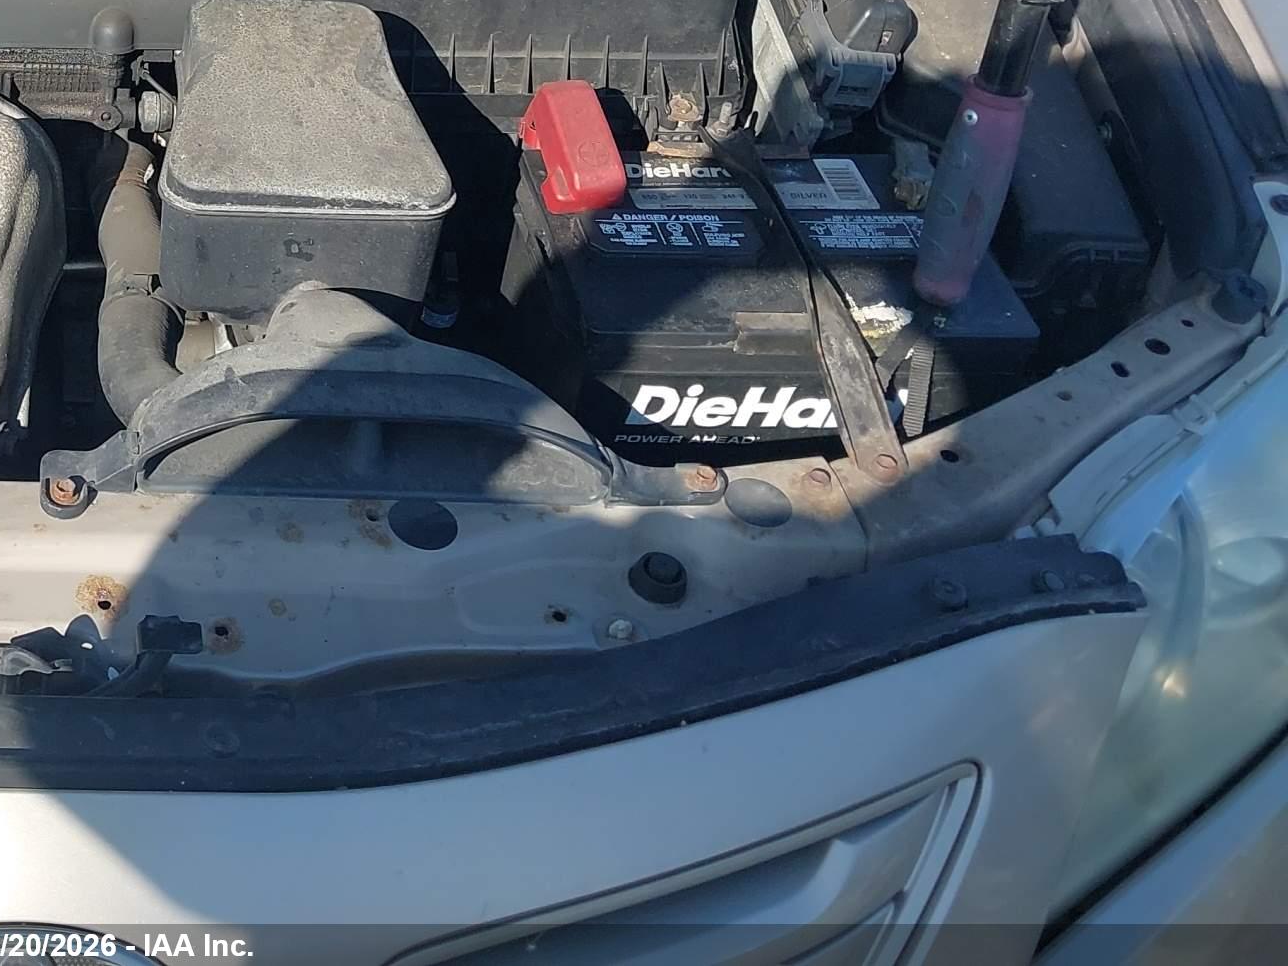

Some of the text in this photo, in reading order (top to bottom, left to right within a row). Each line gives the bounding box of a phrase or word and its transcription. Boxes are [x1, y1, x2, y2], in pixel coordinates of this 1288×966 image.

[624, 162, 732, 179] DieHar
[622, 213, 668, 222] DANGER
[678, 214, 720, 223] POISON
[614, 434, 756, 445] POWER AHEAD
